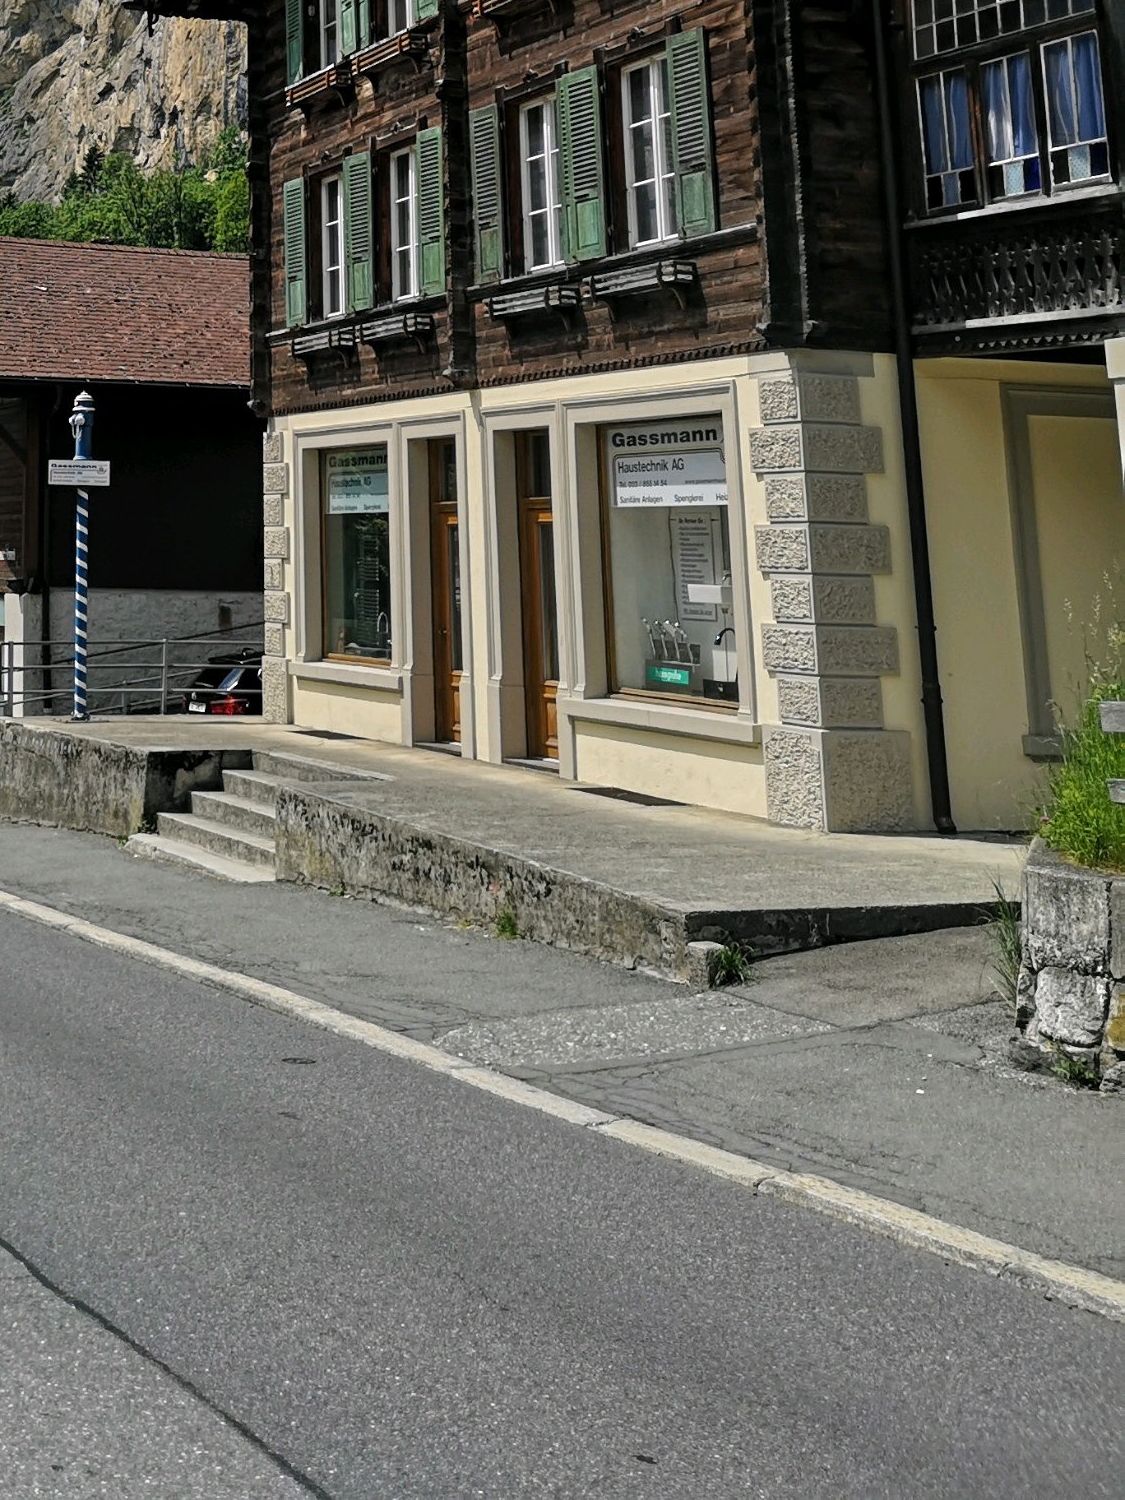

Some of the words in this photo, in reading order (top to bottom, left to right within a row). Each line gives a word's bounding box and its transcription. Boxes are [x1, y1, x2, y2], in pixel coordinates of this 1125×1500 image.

[612, 428, 717, 447] Gassmann
[617, 459, 669, 474] Haustechnik
[671, 457, 685, 471] AG
[642, 495, 663, 504] Anlagen
